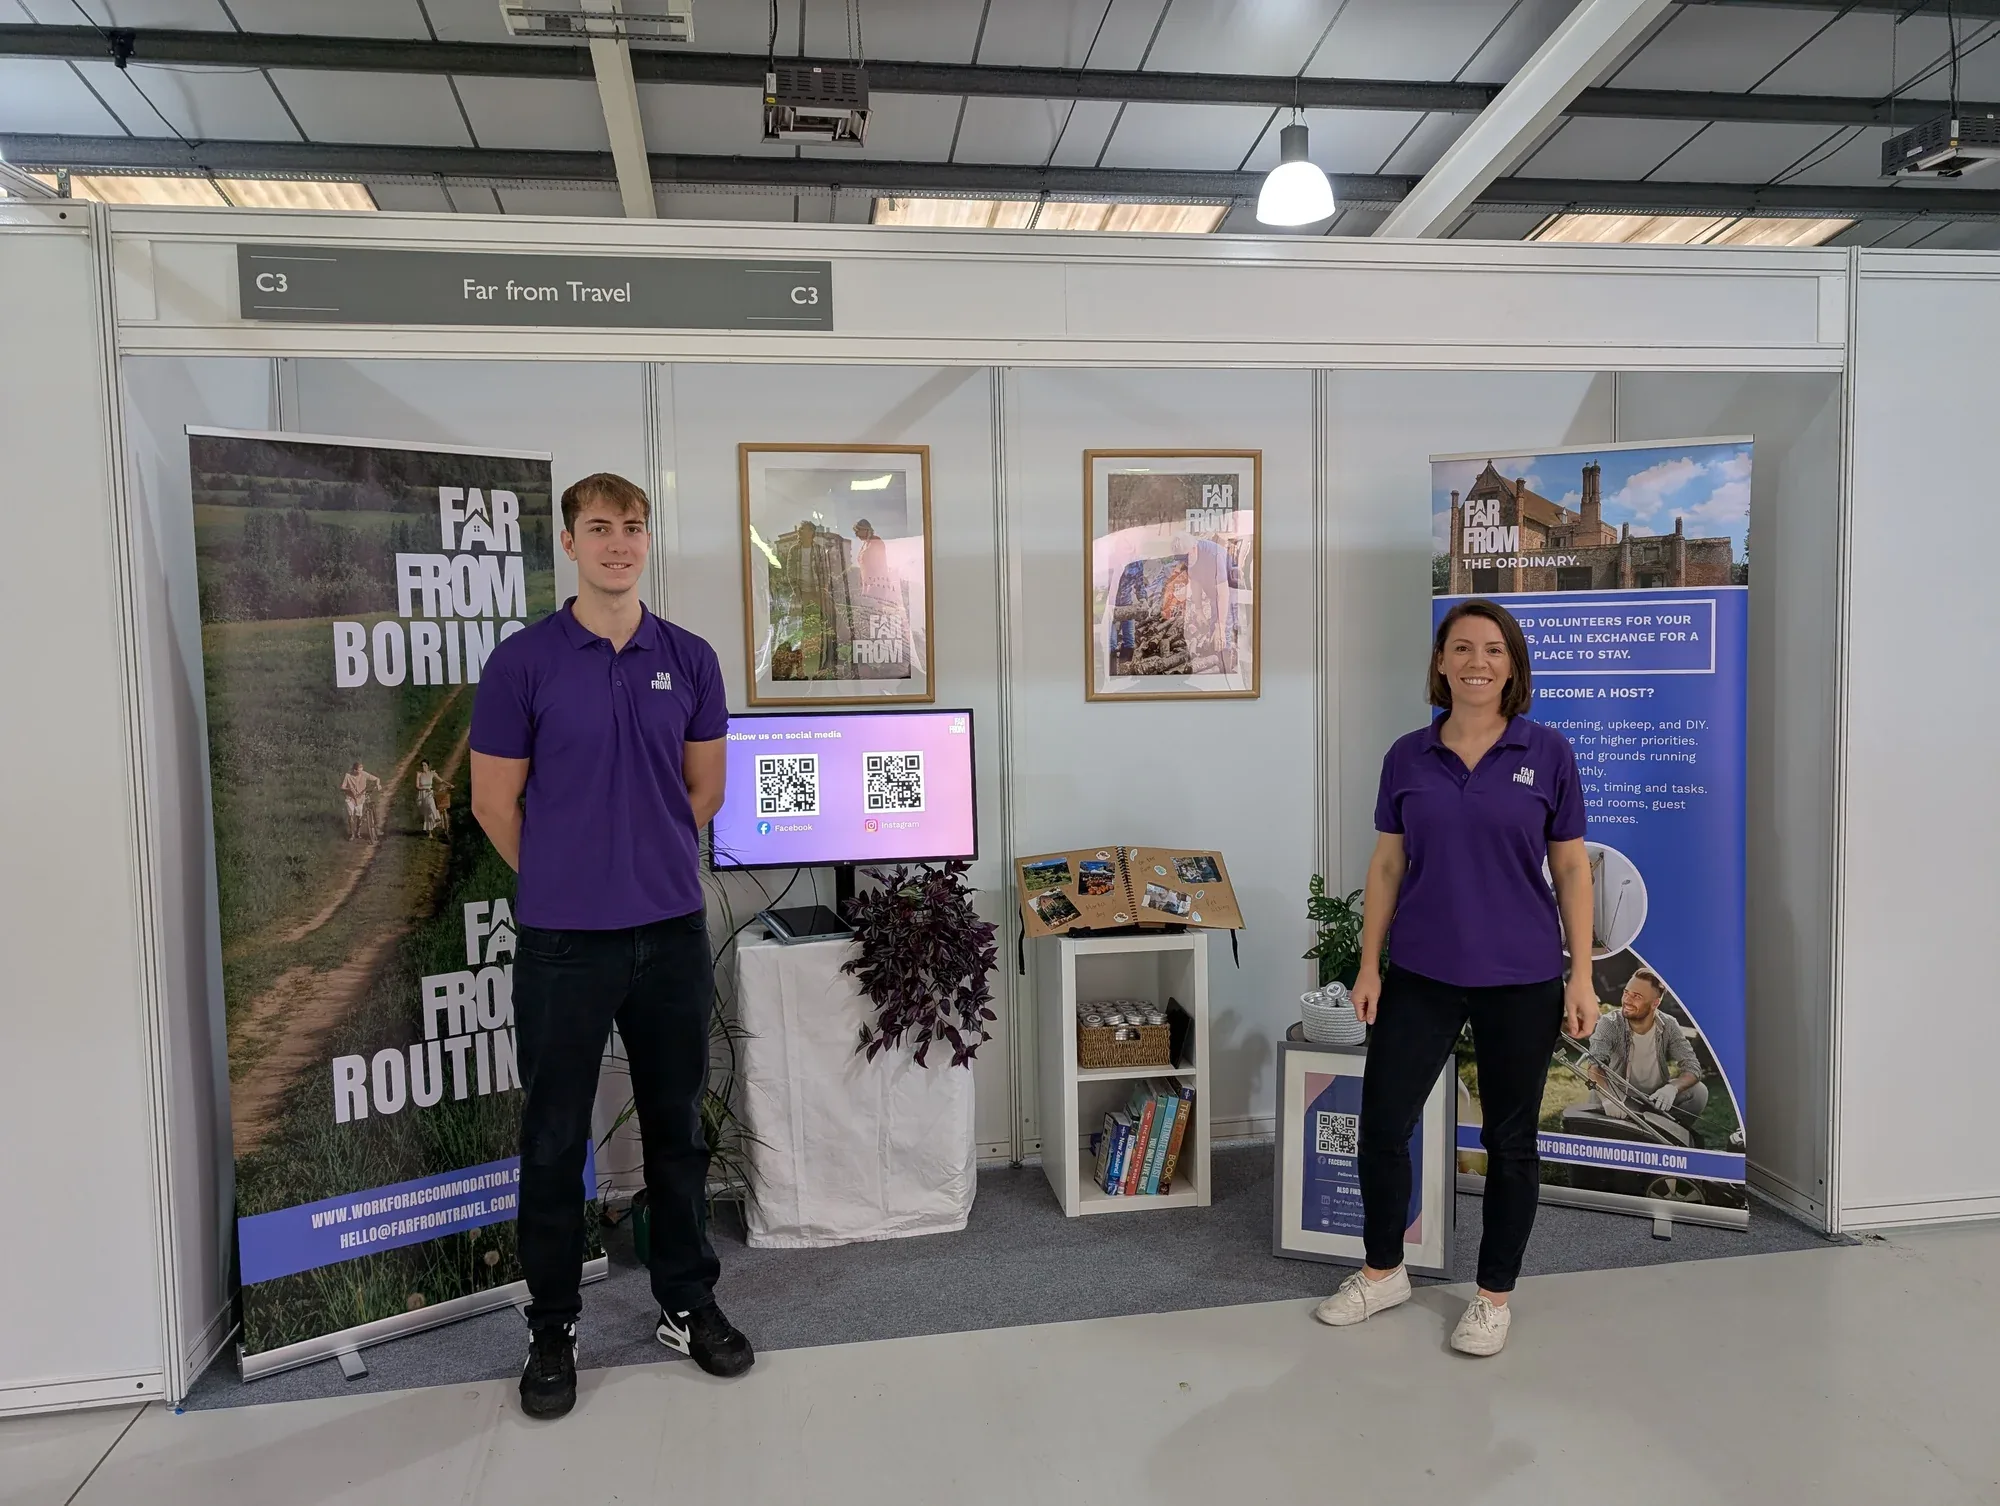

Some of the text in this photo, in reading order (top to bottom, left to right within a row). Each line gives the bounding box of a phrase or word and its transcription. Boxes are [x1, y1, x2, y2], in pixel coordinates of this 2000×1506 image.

[255, 272, 288, 293] C3
[463, 278, 631, 303] Far from Travel
[790, 286, 819, 305] C3
[1203, 483, 1233, 508] FAR
[438, 486, 522, 552] FAR
[1186, 508, 1233, 533] FROM
[1464, 499, 1500, 527] FAR
[1463, 525, 1519, 554] FROM
[1463, 555, 1580, 570] THE ORDINARY.
[396, 552, 527, 618] FROM
[869, 614, 903, 640] FAR
[1538, 616, 1622, 628] VOLUNTEERS
[1626, 616, 1652, 626] FOR
[1655, 614, 1692, 625] YOUR
[1542, 634, 1566, 644] ALL
[1569, 633, 1583, 643] IN
[1586, 632, 1656, 643] EXCHANGE
[1659, 631, 1686, 642] FOR
[1689, 631, 1699, 641] A
[853, 639, 904, 664] FROM
[1533, 649, 1632, 660] PLACE TO STAY.
[656, 671, 671, 681] FAR
[651, 680, 672, 690] FROM
[1539, 688, 1594, 699] BECOME
[1597, 688, 1607, 698] A
[1610, 687, 1655, 699] HOST?
[1607, 719, 1655, 731] upkeep,
[1658, 719, 1682, 730] and
[1686, 719, 1709, 730] DIY.
[726, 732, 757, 741] Follow
[785, 731, 812, 740] social
[814, 730, 842, 739] media
[1579, 734, 1597, 745] for
[1600, 734, 1637, 747] higher
[1641, 735, 1699, 747] priorities.
[1597, 751, 1646, 763] grounds
[1650, 752, 1697, 764] running
[1603, 782, 1642, 795] timing
[1645, 783, 1668, 794] and
[1671, 783, 1708, 795] tasks.
[1607, 800, 1649, 810] rooms,
[1652, 800, 1687, 811] guest
[881, 820, 920, 831] Instagram
[1587, 815, 1639, 825] annexes.
[774, 823, 813, 833] Facebook
[464, 898, 518, 966] FA
[332, 1026, 522, 1124] ROUTIN
[1178, 1103, 1189, 1120] THE
[1113, 1150, 1123, 1175] Zealand
[1163, 1154, 1177, 1180] BOOK
[1328, 1158, 1352, 1167] FACEBOOK
[1337, 1186, 1349, 1195] ALSO
[340, 1193, 516, 1249] HELLO@FARFROMTRAVEL.COM
